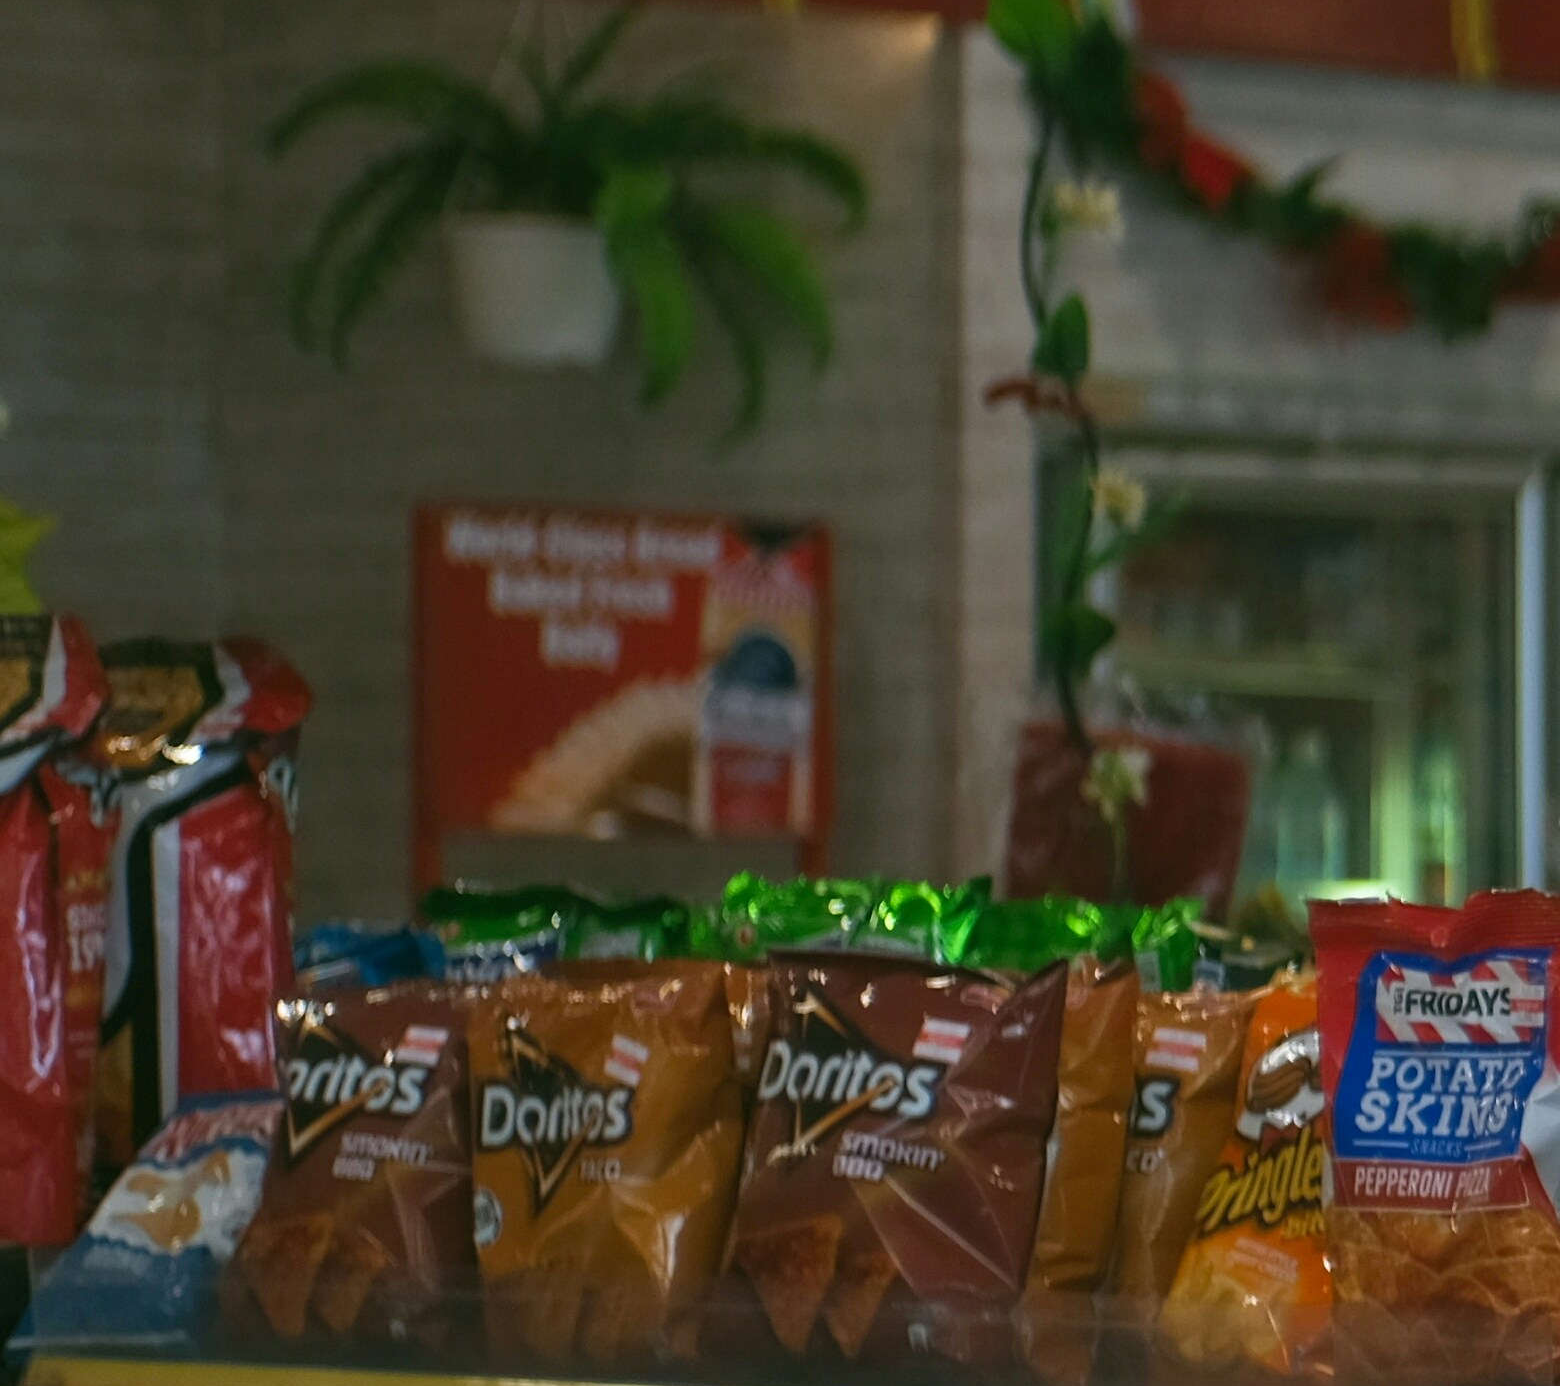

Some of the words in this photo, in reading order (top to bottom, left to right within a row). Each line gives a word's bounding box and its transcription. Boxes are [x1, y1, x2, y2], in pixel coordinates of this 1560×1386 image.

[1404, 984, 1511, 1018] FRIDAYS
[758, 1037, 942, 1120] Doritos
[1366, 1056, 1526, 1094] POTATO
[481, 1082, 635, 1149] Doritos
[1355, 1090, 1514, 1139] SKINS
[1411, 1139, 1462, 1158] SNACKS
[1354, 1166, 1450, 1199] PEPPERONI
[1456, 1169, 1492, 1198] PIZZA
